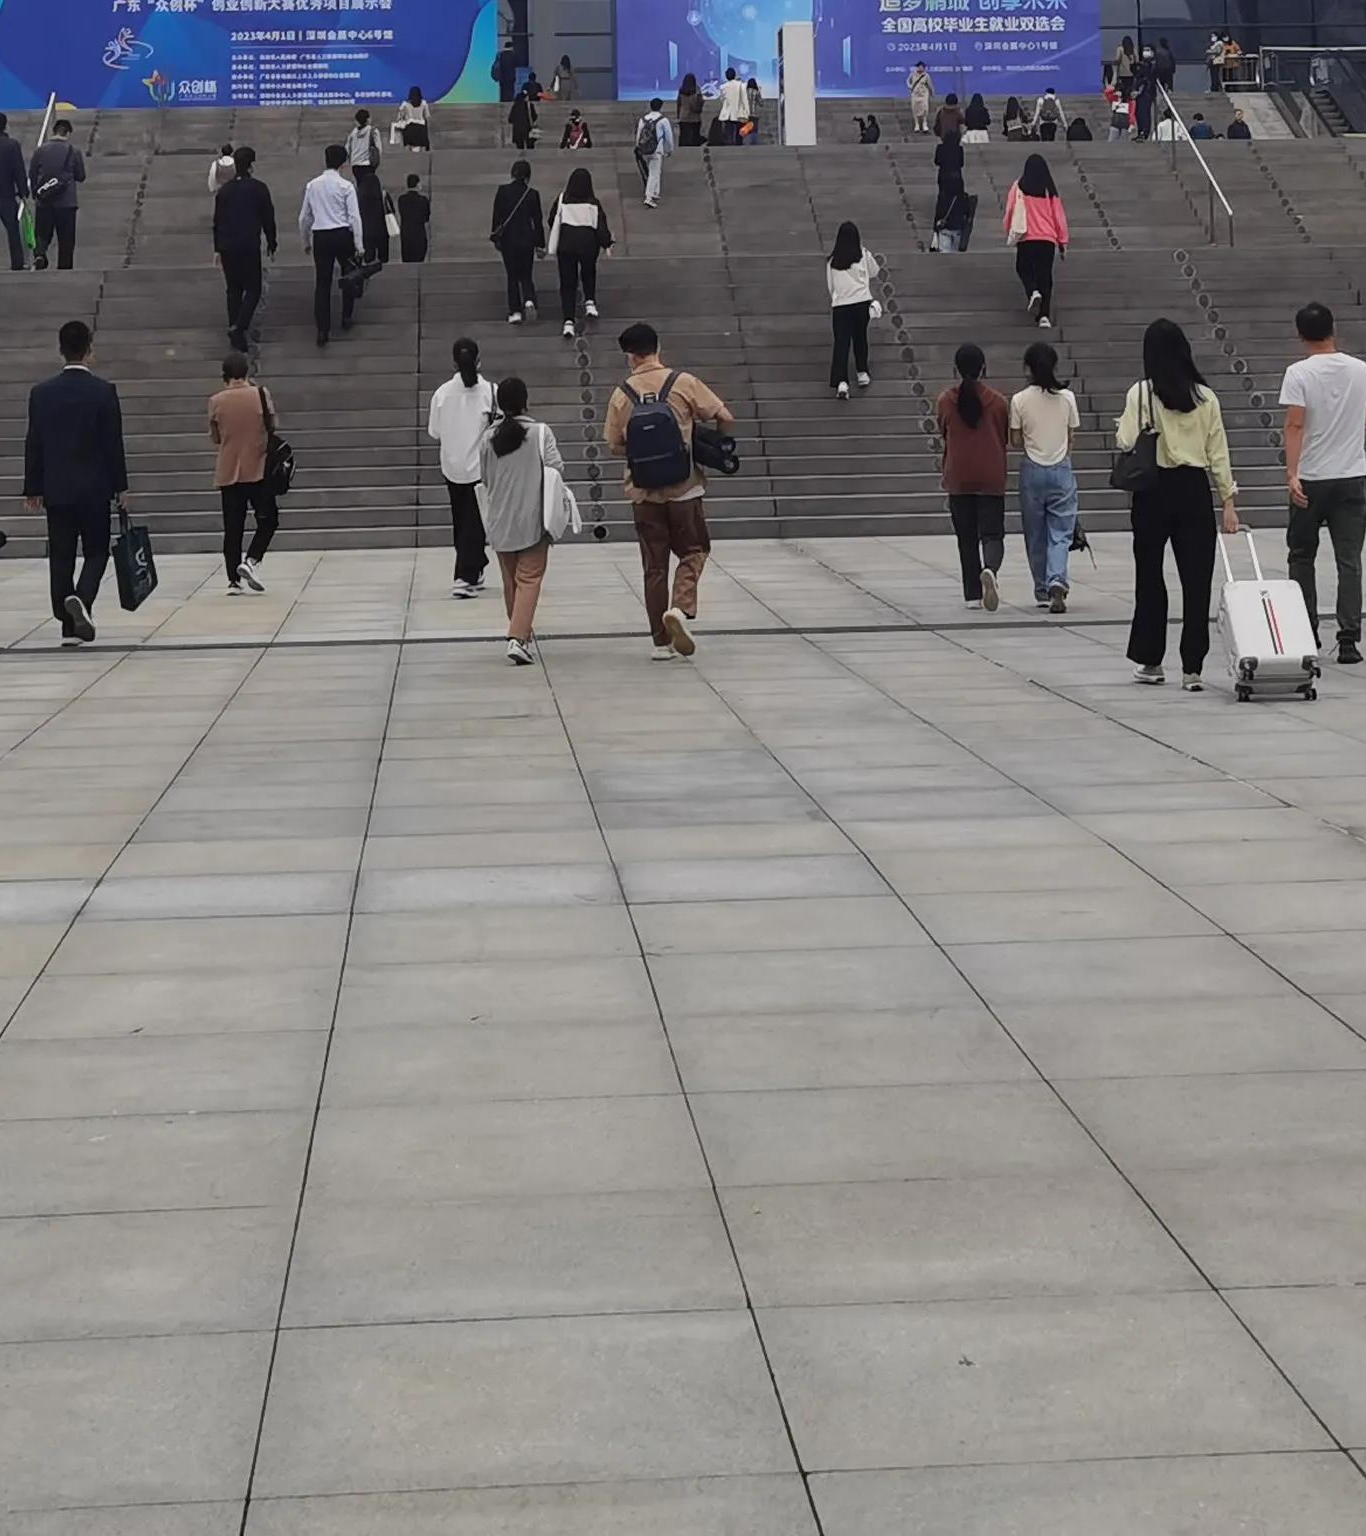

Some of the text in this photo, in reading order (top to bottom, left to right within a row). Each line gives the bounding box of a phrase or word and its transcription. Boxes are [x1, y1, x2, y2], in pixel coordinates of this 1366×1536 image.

[881, 15, 1066, 34] 全国高校毕业生就业双选会
